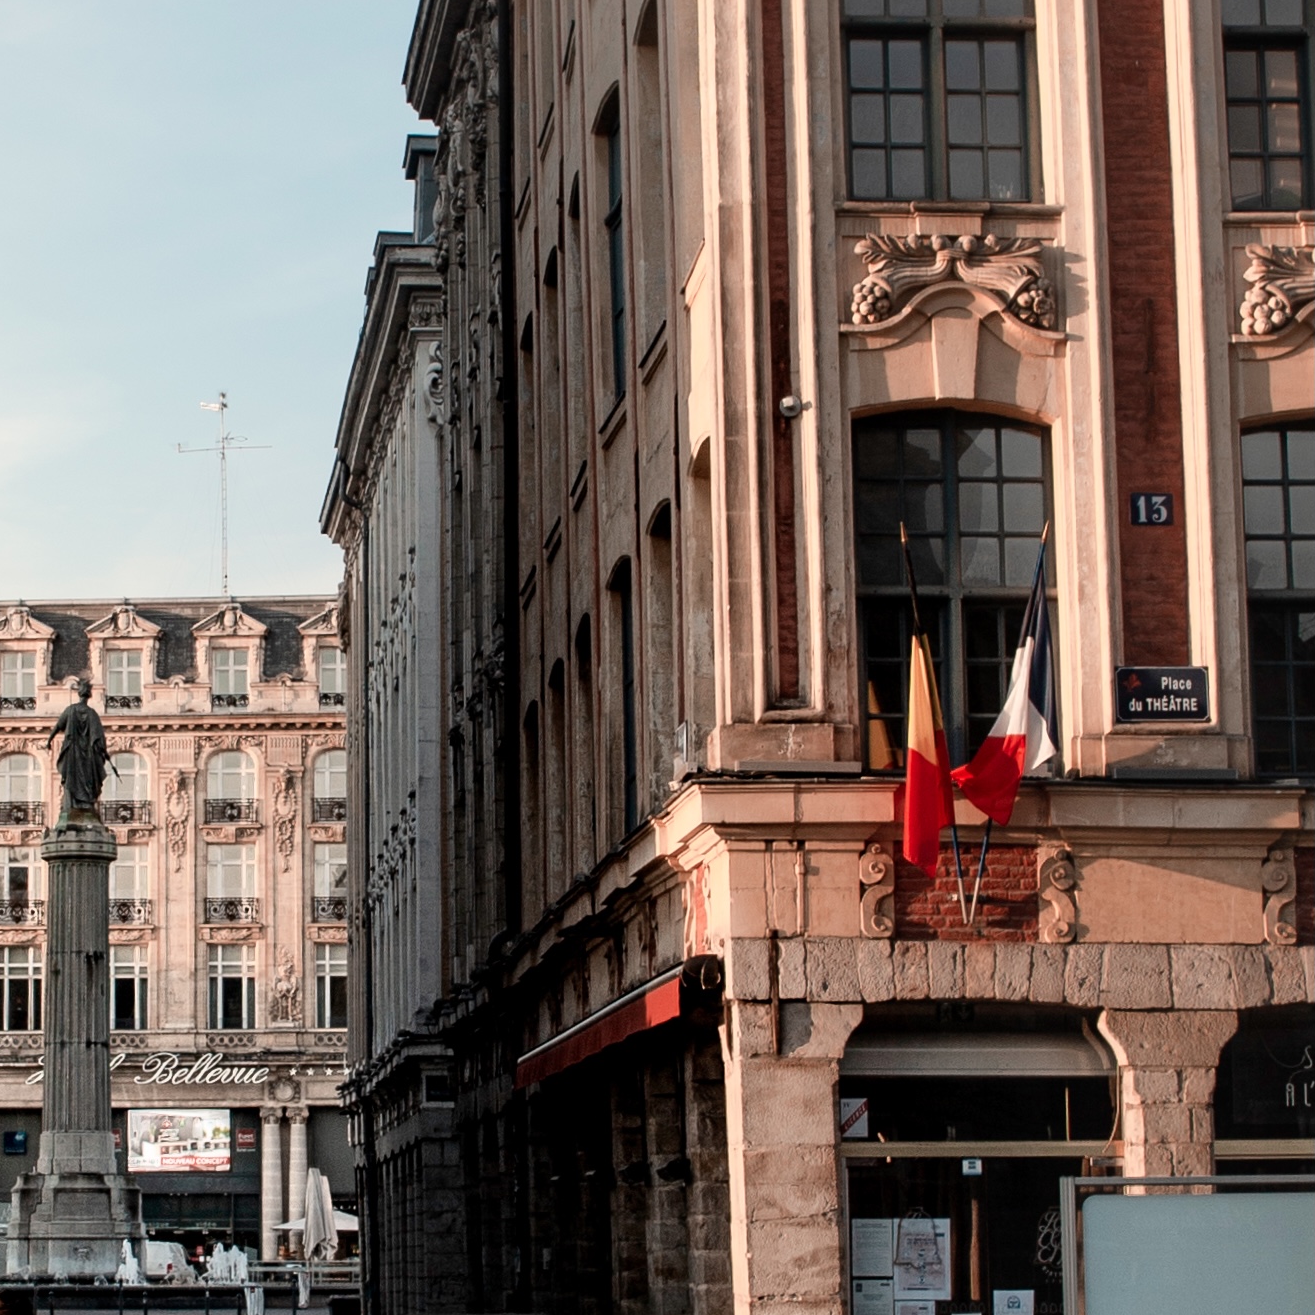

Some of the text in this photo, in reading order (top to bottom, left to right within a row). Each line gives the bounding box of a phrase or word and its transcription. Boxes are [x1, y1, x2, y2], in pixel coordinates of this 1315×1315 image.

[1136, 495, 1168, 524] 13
[1161, 676, 1192, 690] Place
[1129, 695, 1198, 711] du THÉÂTRE
[134, 1052, 270, 1085] Bellevue
[162, 1157, 195, 1165] NOUVEAU
[196, 1157, 228, 1165] CONCEPT
